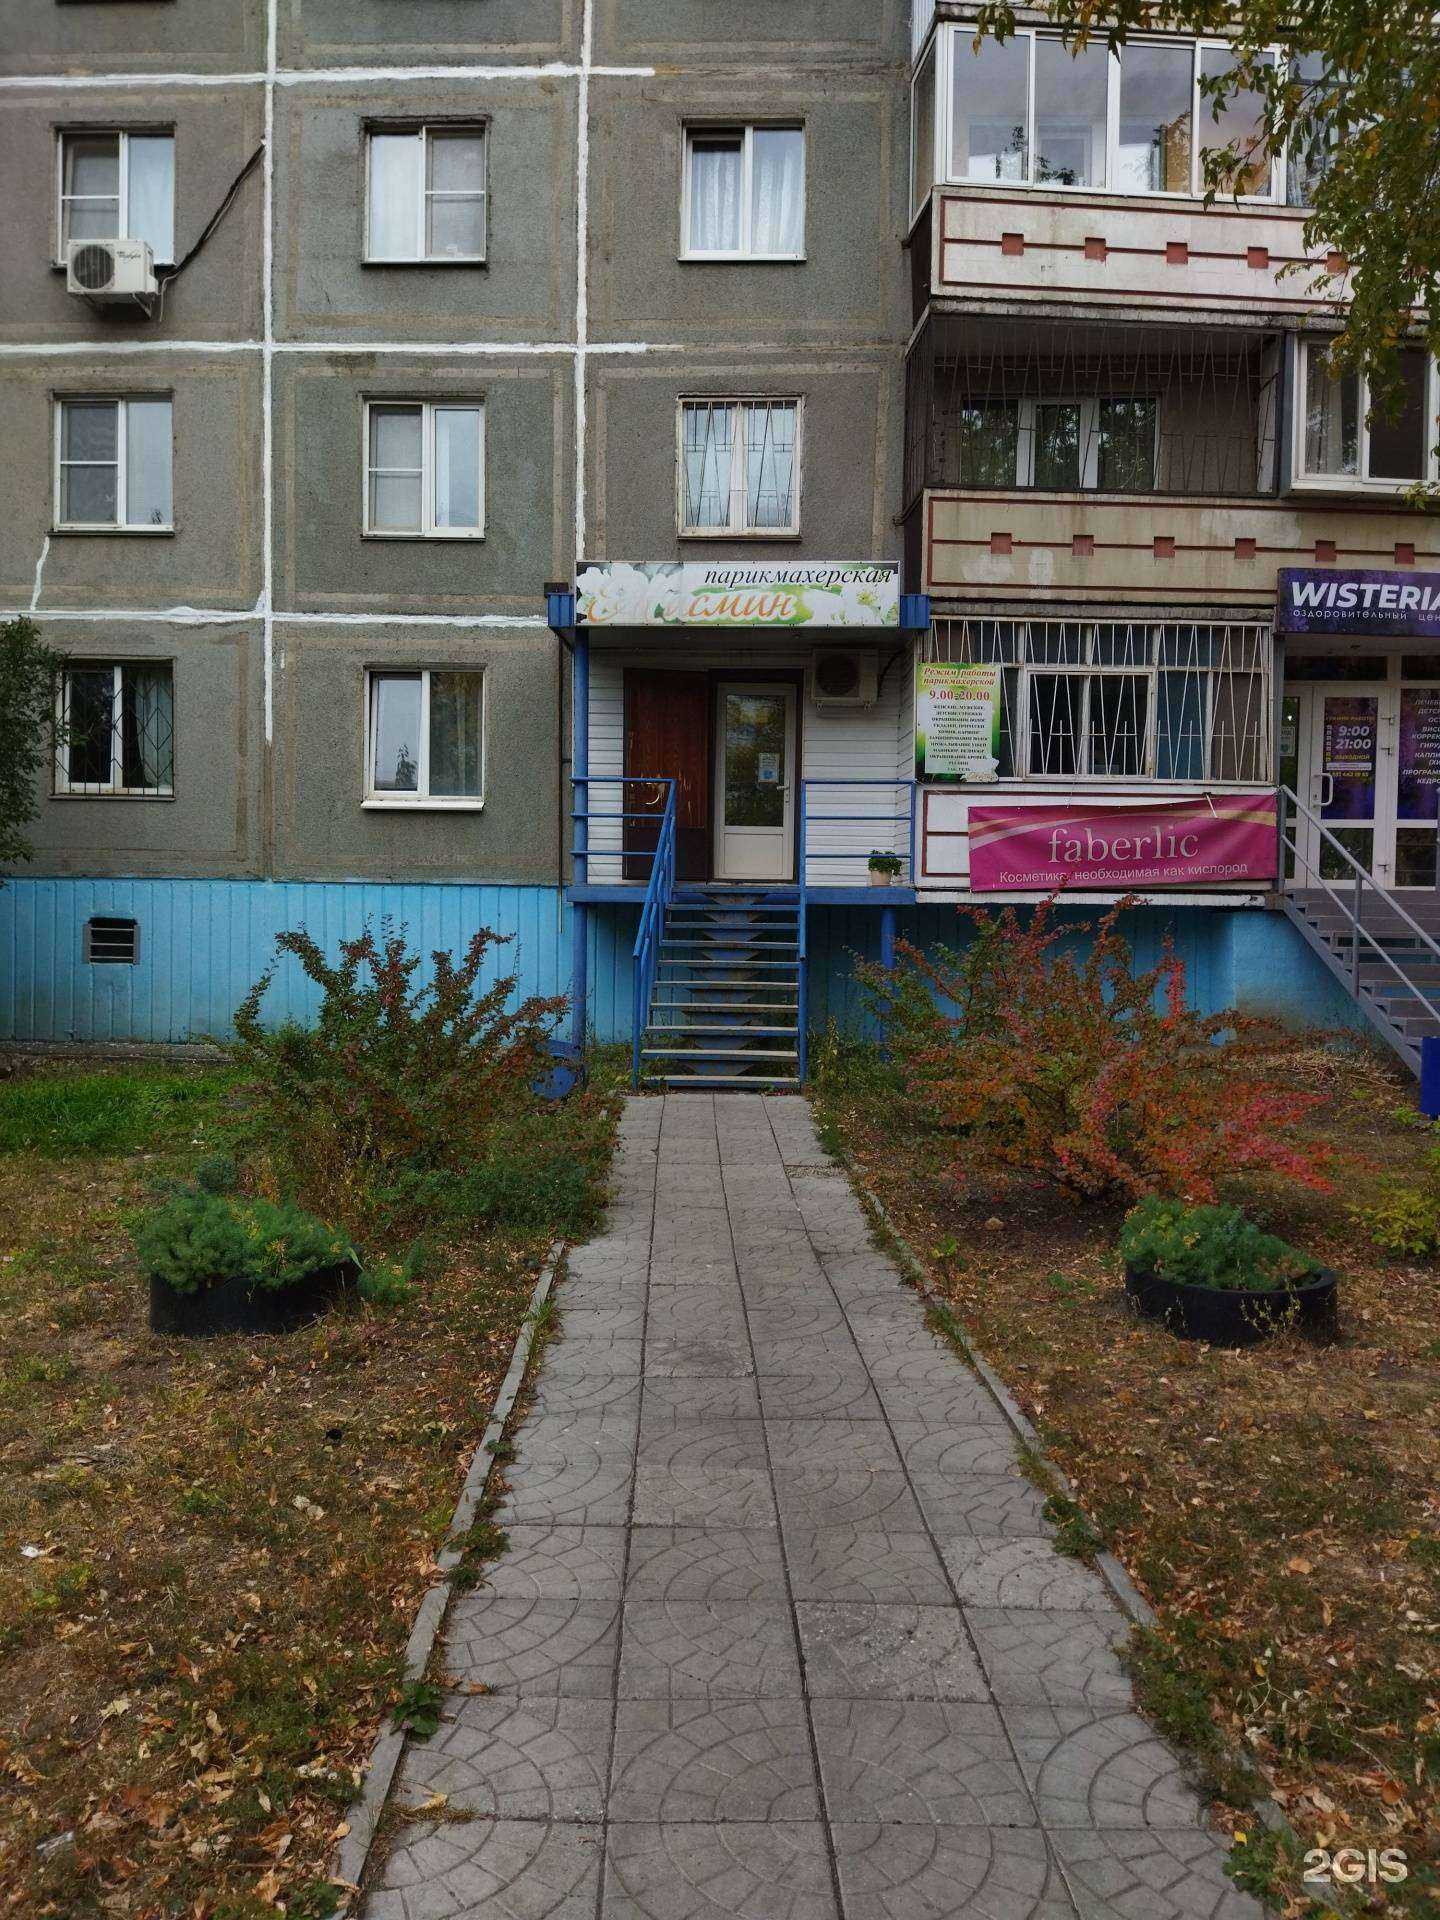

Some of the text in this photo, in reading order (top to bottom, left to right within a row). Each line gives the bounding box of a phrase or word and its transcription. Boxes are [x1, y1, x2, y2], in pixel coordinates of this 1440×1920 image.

[705, 569, 892, 588] парикмахерская
[1293, 609, 1407, 620] оздоровительный
[924, 667, 997, 678] Режим работы
[1338, 725, 1370, 737] 9:00
[1335, 738, 1372, 750] 21:00
[1048, 825, 1200, 864] faberlic
[1074, 868, 1160, 881] необходимая
[1163, 867, 1184, 877] как
[1187, 863, 1248, 876] кислород
